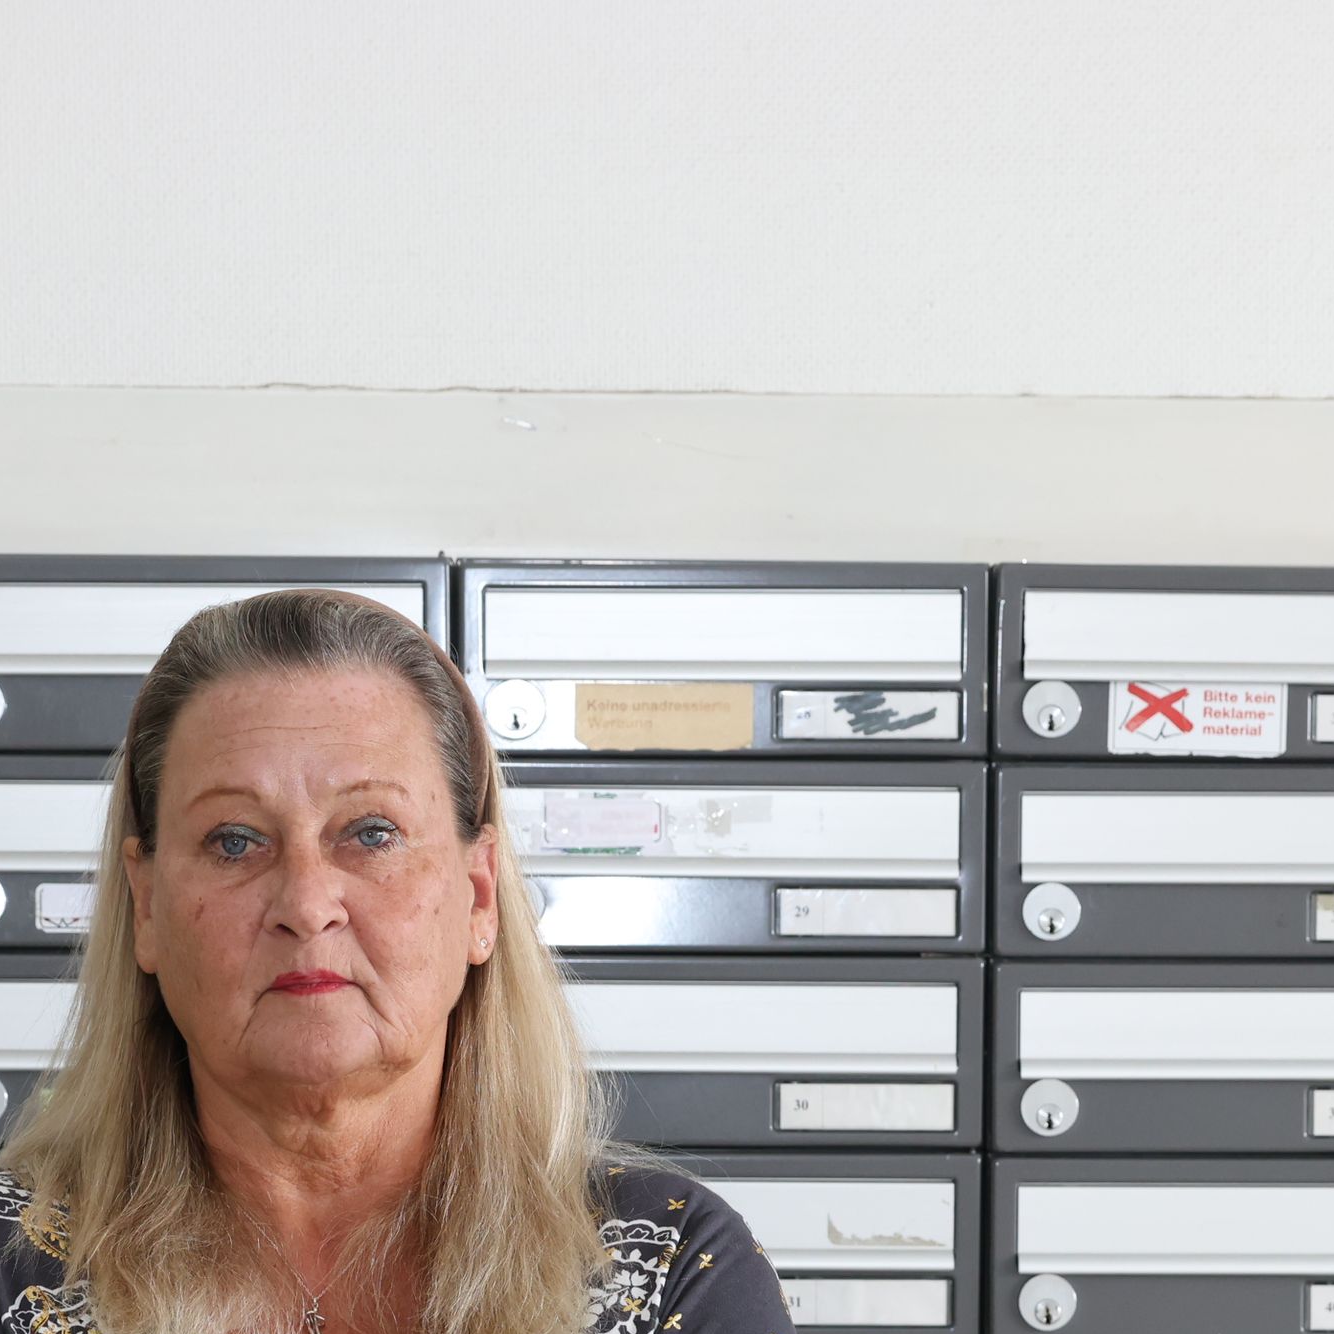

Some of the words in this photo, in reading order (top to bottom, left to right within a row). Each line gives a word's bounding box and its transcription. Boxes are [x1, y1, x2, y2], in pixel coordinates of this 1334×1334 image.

[1203, 689, 1239, 704] Bitte
[1245, 691, 1276, 704] kein
[586, 699, 628, 713] Keine
[632, 699, 733, 713] unadressierte
[1202, 705, 1275, 720] Reklame-
[1201, 723, 1263, 737] material
[794, 905, 810, 918] 29
[795, 1099, 809, 1111] 30
